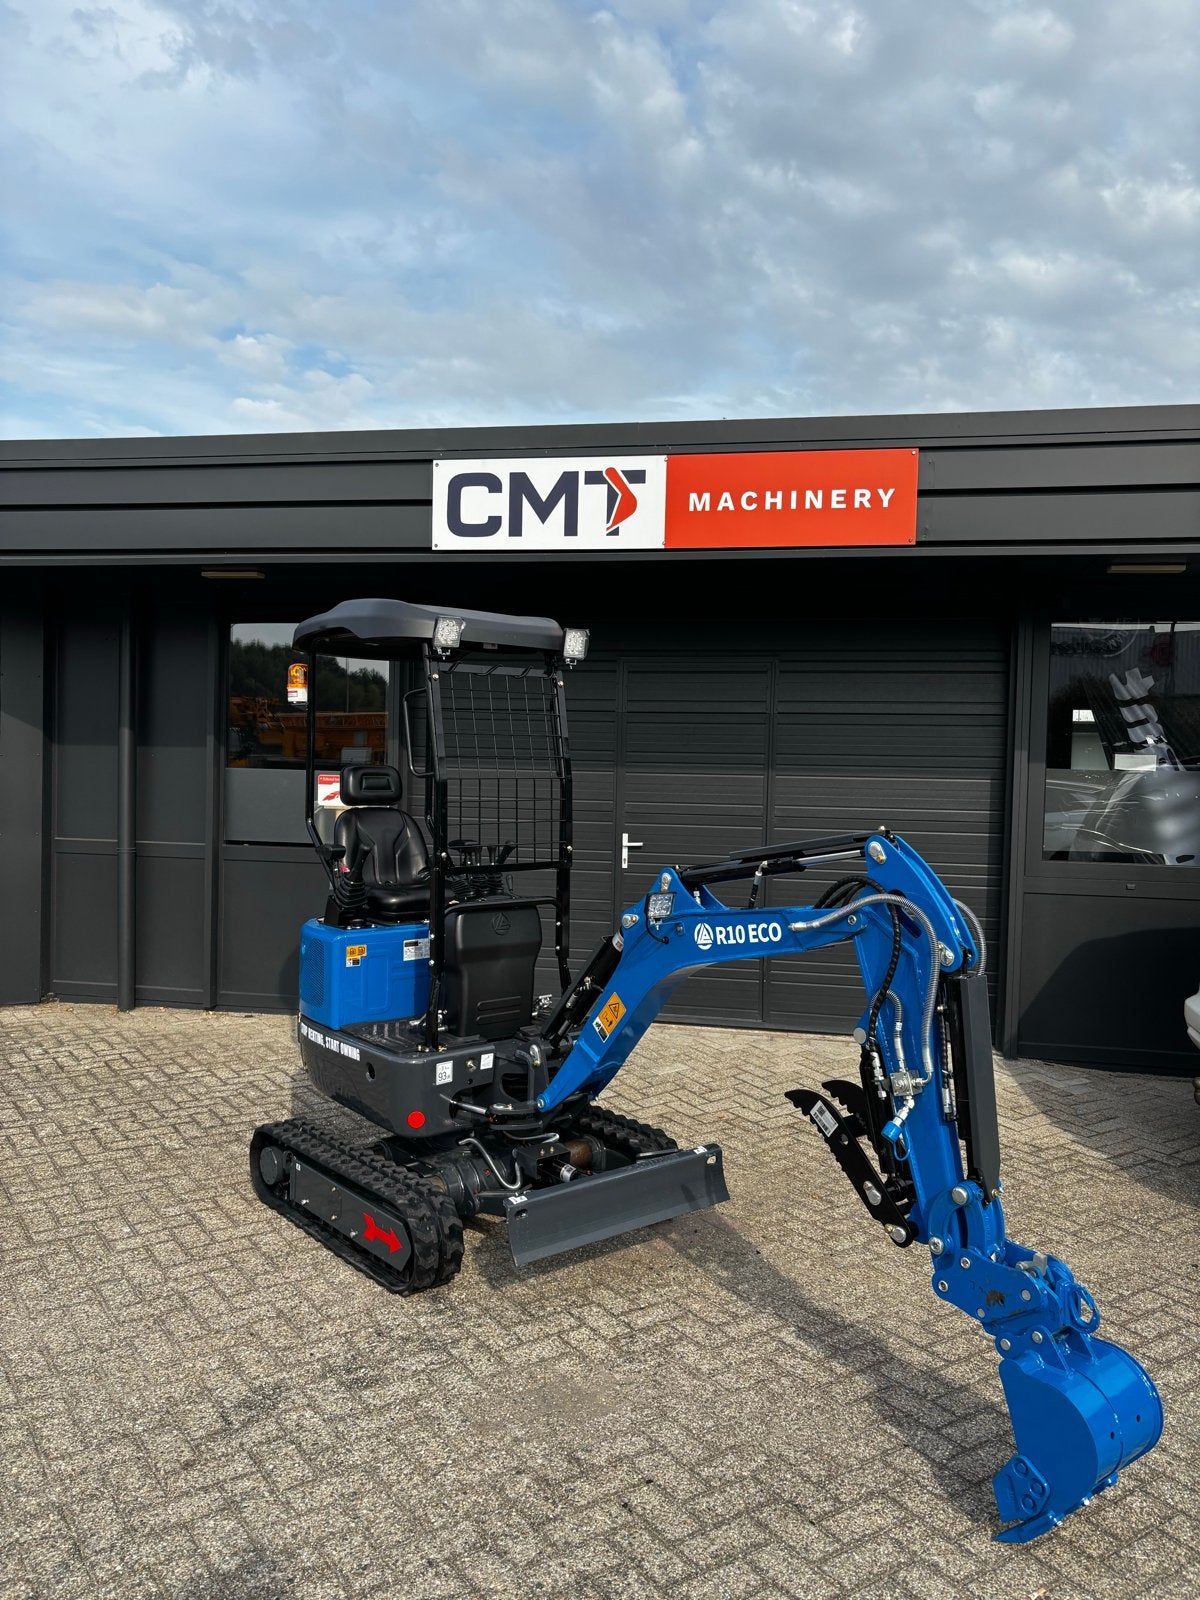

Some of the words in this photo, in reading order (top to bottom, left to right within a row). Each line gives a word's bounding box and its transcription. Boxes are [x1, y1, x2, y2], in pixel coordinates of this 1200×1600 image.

[446, 468, 647, 538] CMT
[688, 488, 896, 512] MACHINERY
[715, 925, 745, 945] R10
[747, 922, 782, 943] ECO
[325, 1036, 340, 1053] START
[340, 1042, 360, 1061] OWNING
[437, 1071, 447, 1082] 93
